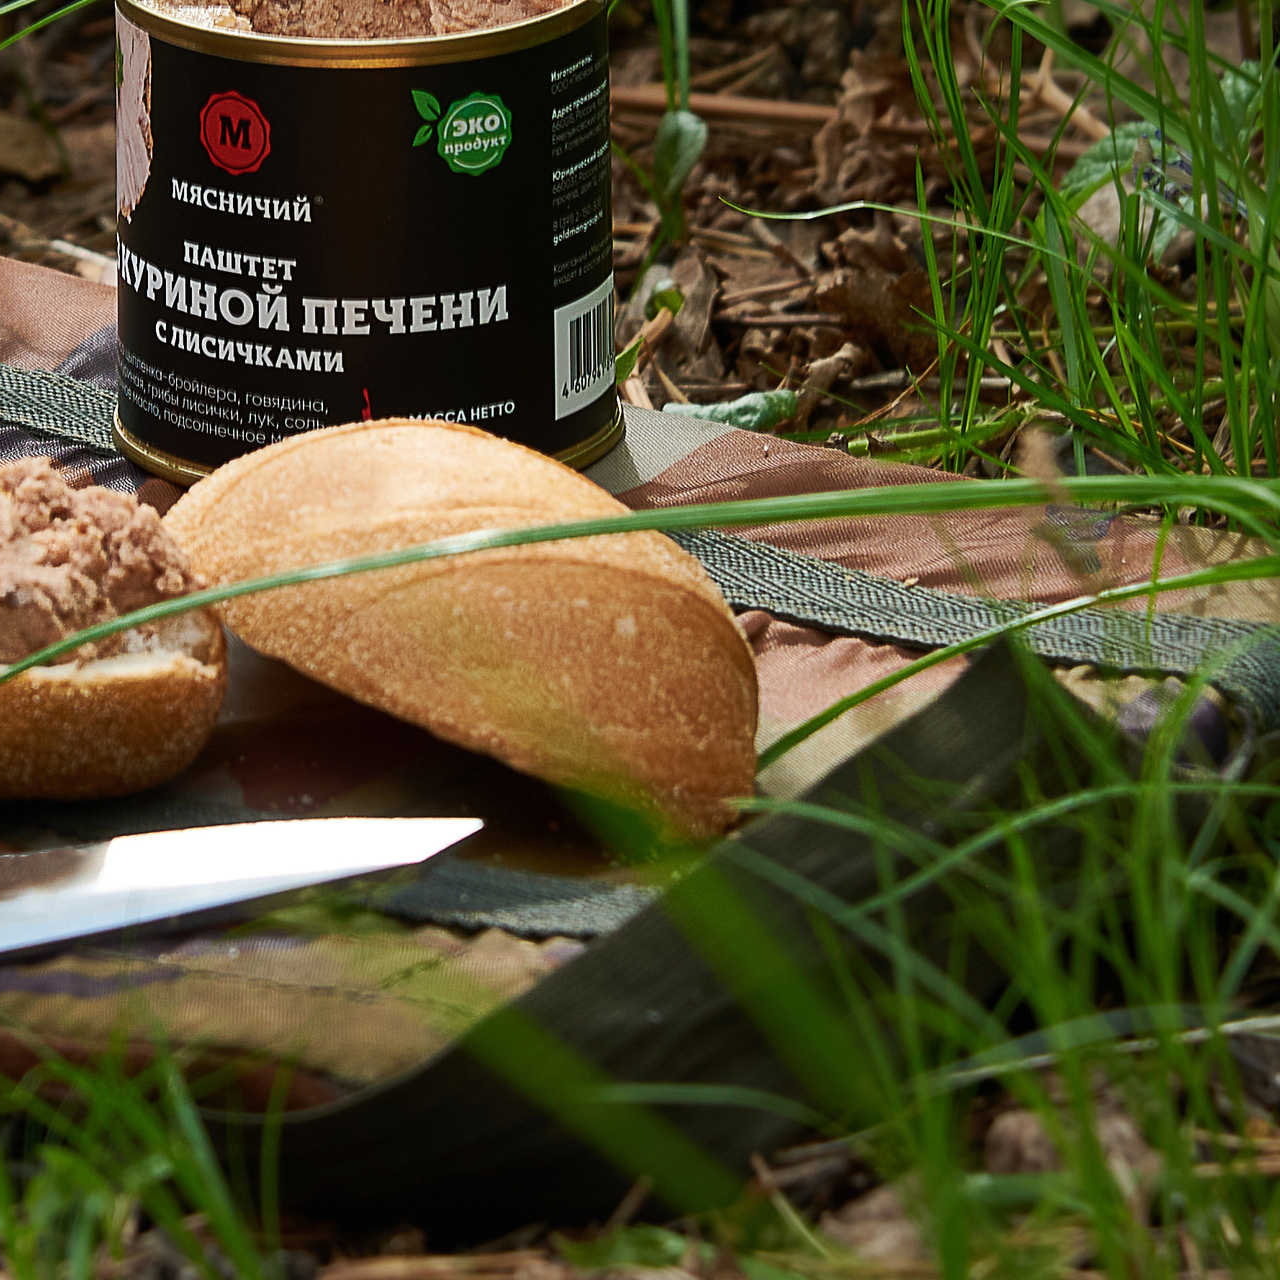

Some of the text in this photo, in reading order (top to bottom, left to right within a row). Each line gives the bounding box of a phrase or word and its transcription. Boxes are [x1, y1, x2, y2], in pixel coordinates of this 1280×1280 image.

[219, 115, 252, 150] М
[452, 113, 500, 137] ЭКО
[444, 135, 507, 157] продукт
[171, 176, 312, 223] МЯСНИЧИЙ
[183, 239, 297, 282] ПАШТЕТ
[121, 241, 290, 332] КУРИНОЙ
[302, 283, 508, 335] ПЕЧЕНИ
[155, 318, 345, 373] С ЛИСИЧКАМИ
[147, 383, 179, 407] грибы
[182, 398, 243, 424] лисички,
[245, 392, 329, 415] говядина,
[470, 399, 516, 422] НЕТТО
[163, 409, 266, 445] подсолнечное
